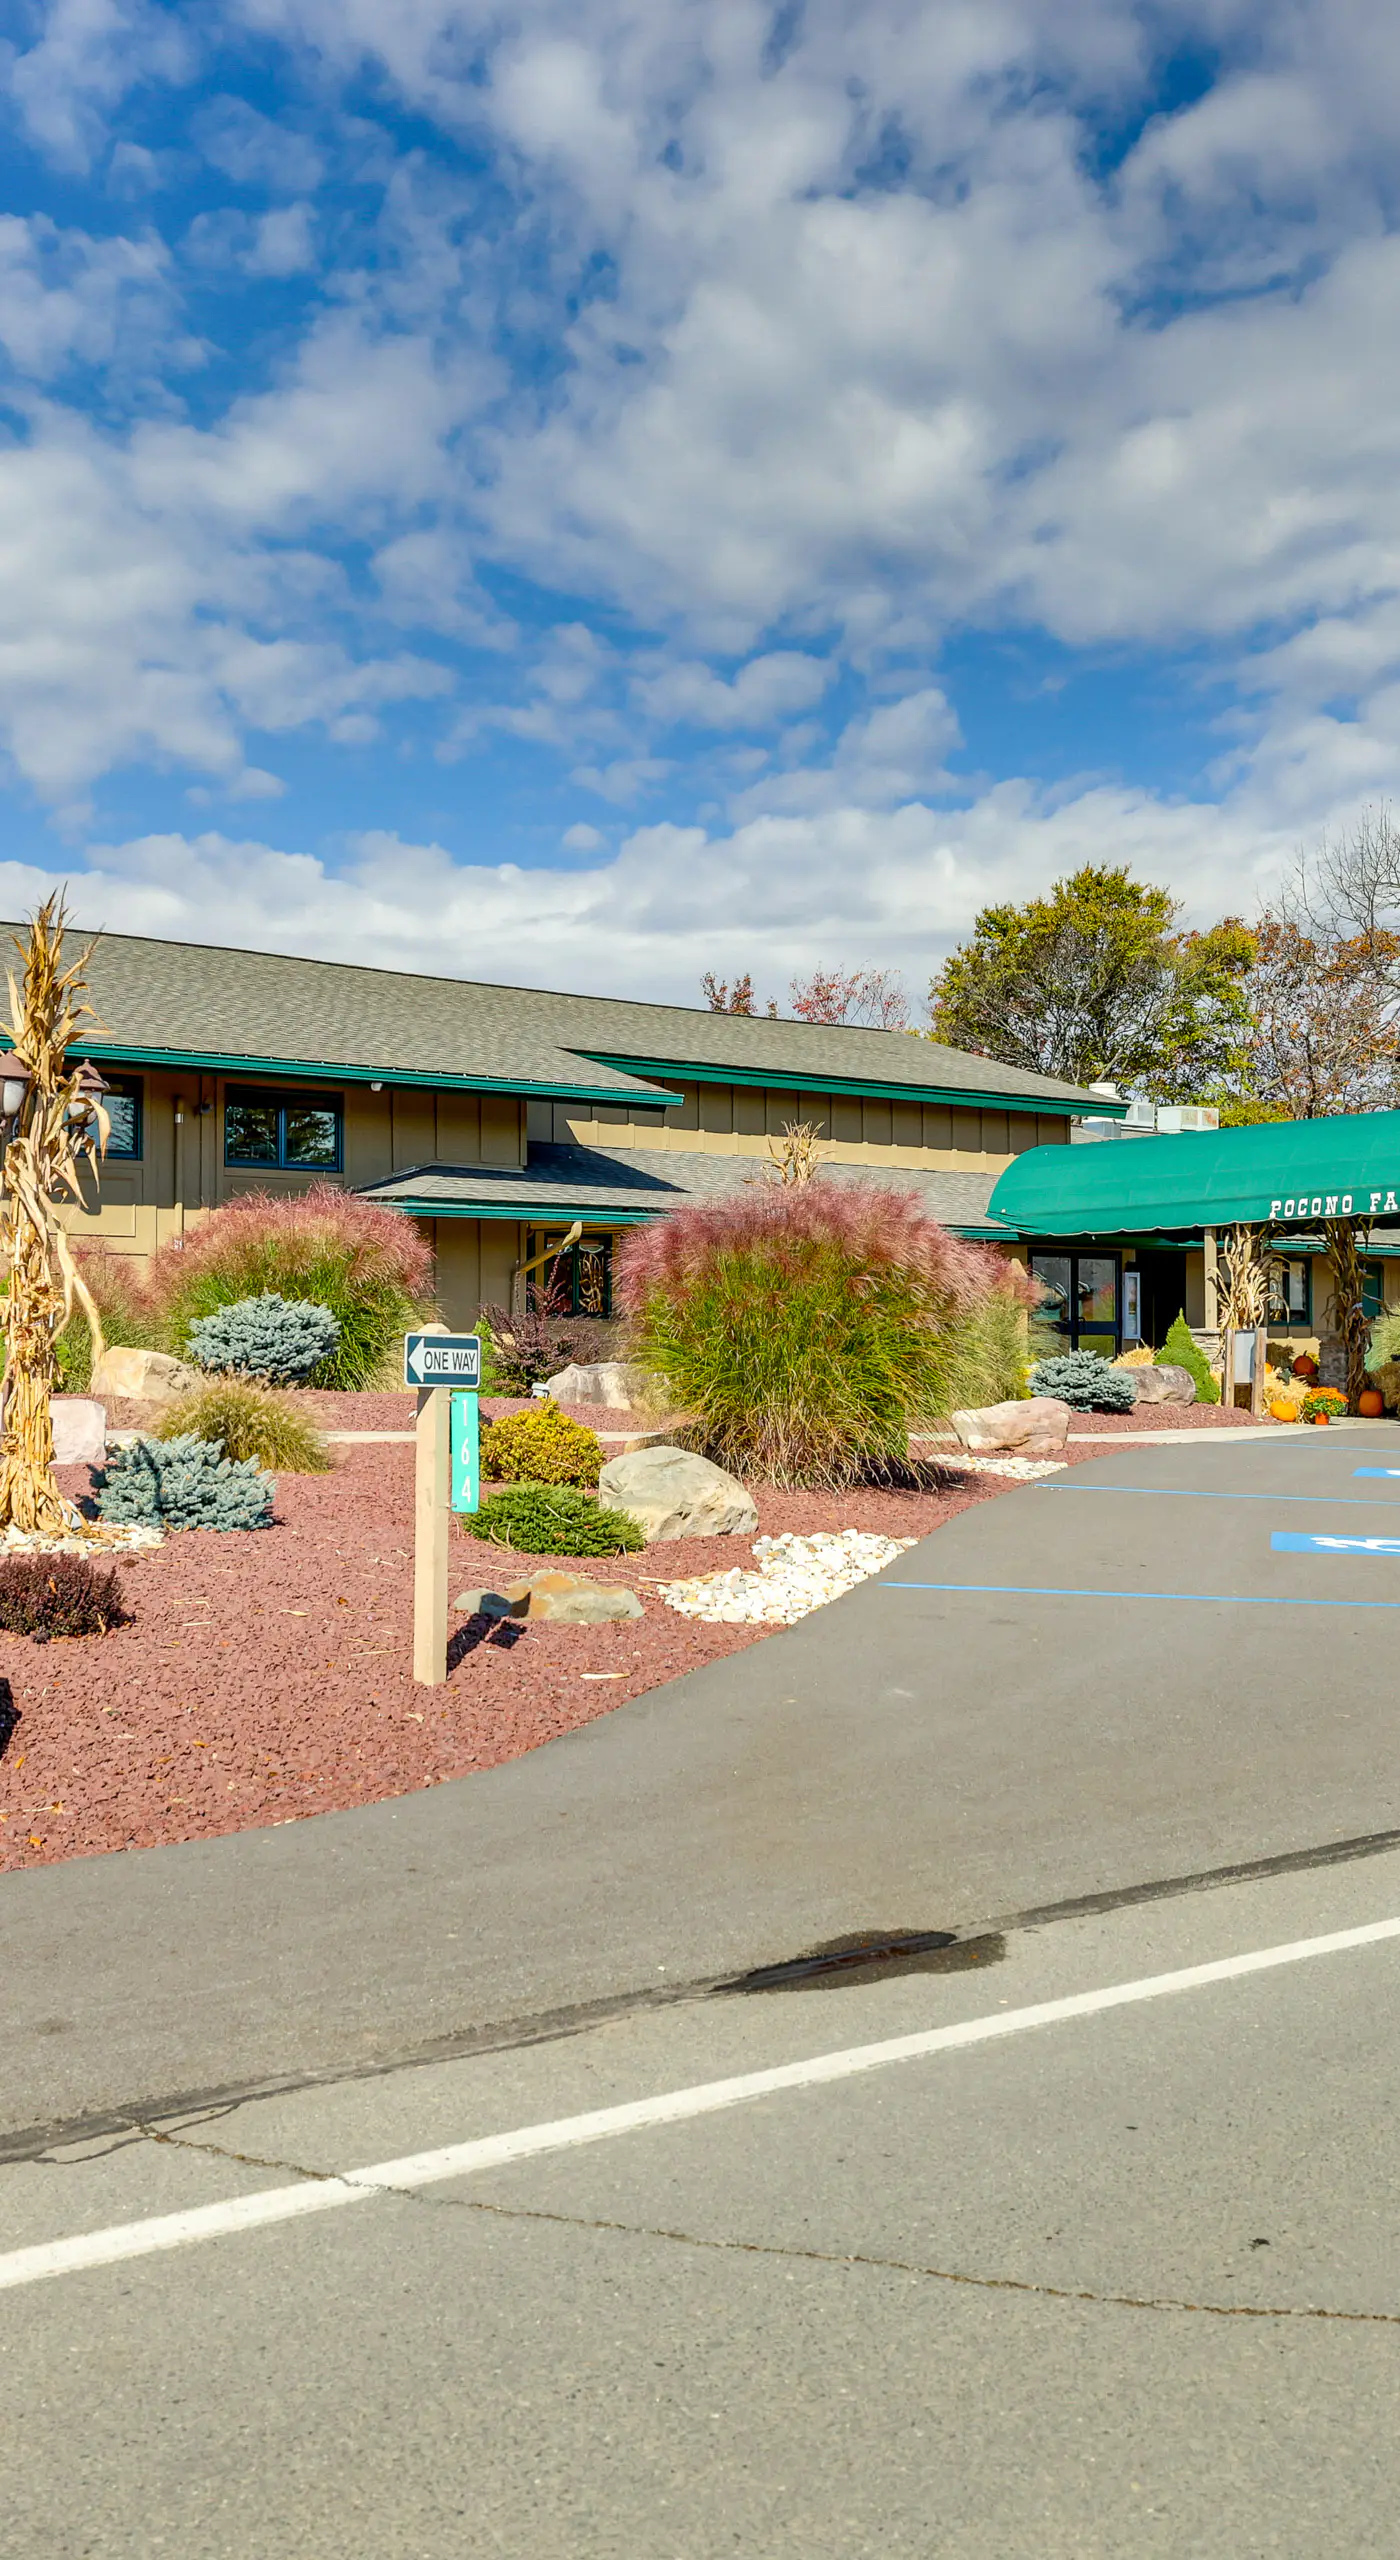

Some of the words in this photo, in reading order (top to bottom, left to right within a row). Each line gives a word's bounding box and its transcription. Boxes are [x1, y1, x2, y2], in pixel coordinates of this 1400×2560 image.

[1269, 1194, 1353, 1218] POCONO
[1369, 1191, 1398, 1212] FA
[424, 1351, 448, 1370] ONE
[452, 1352, 476, 1371] WAY
[461, 1399, 472, 1503] 164
